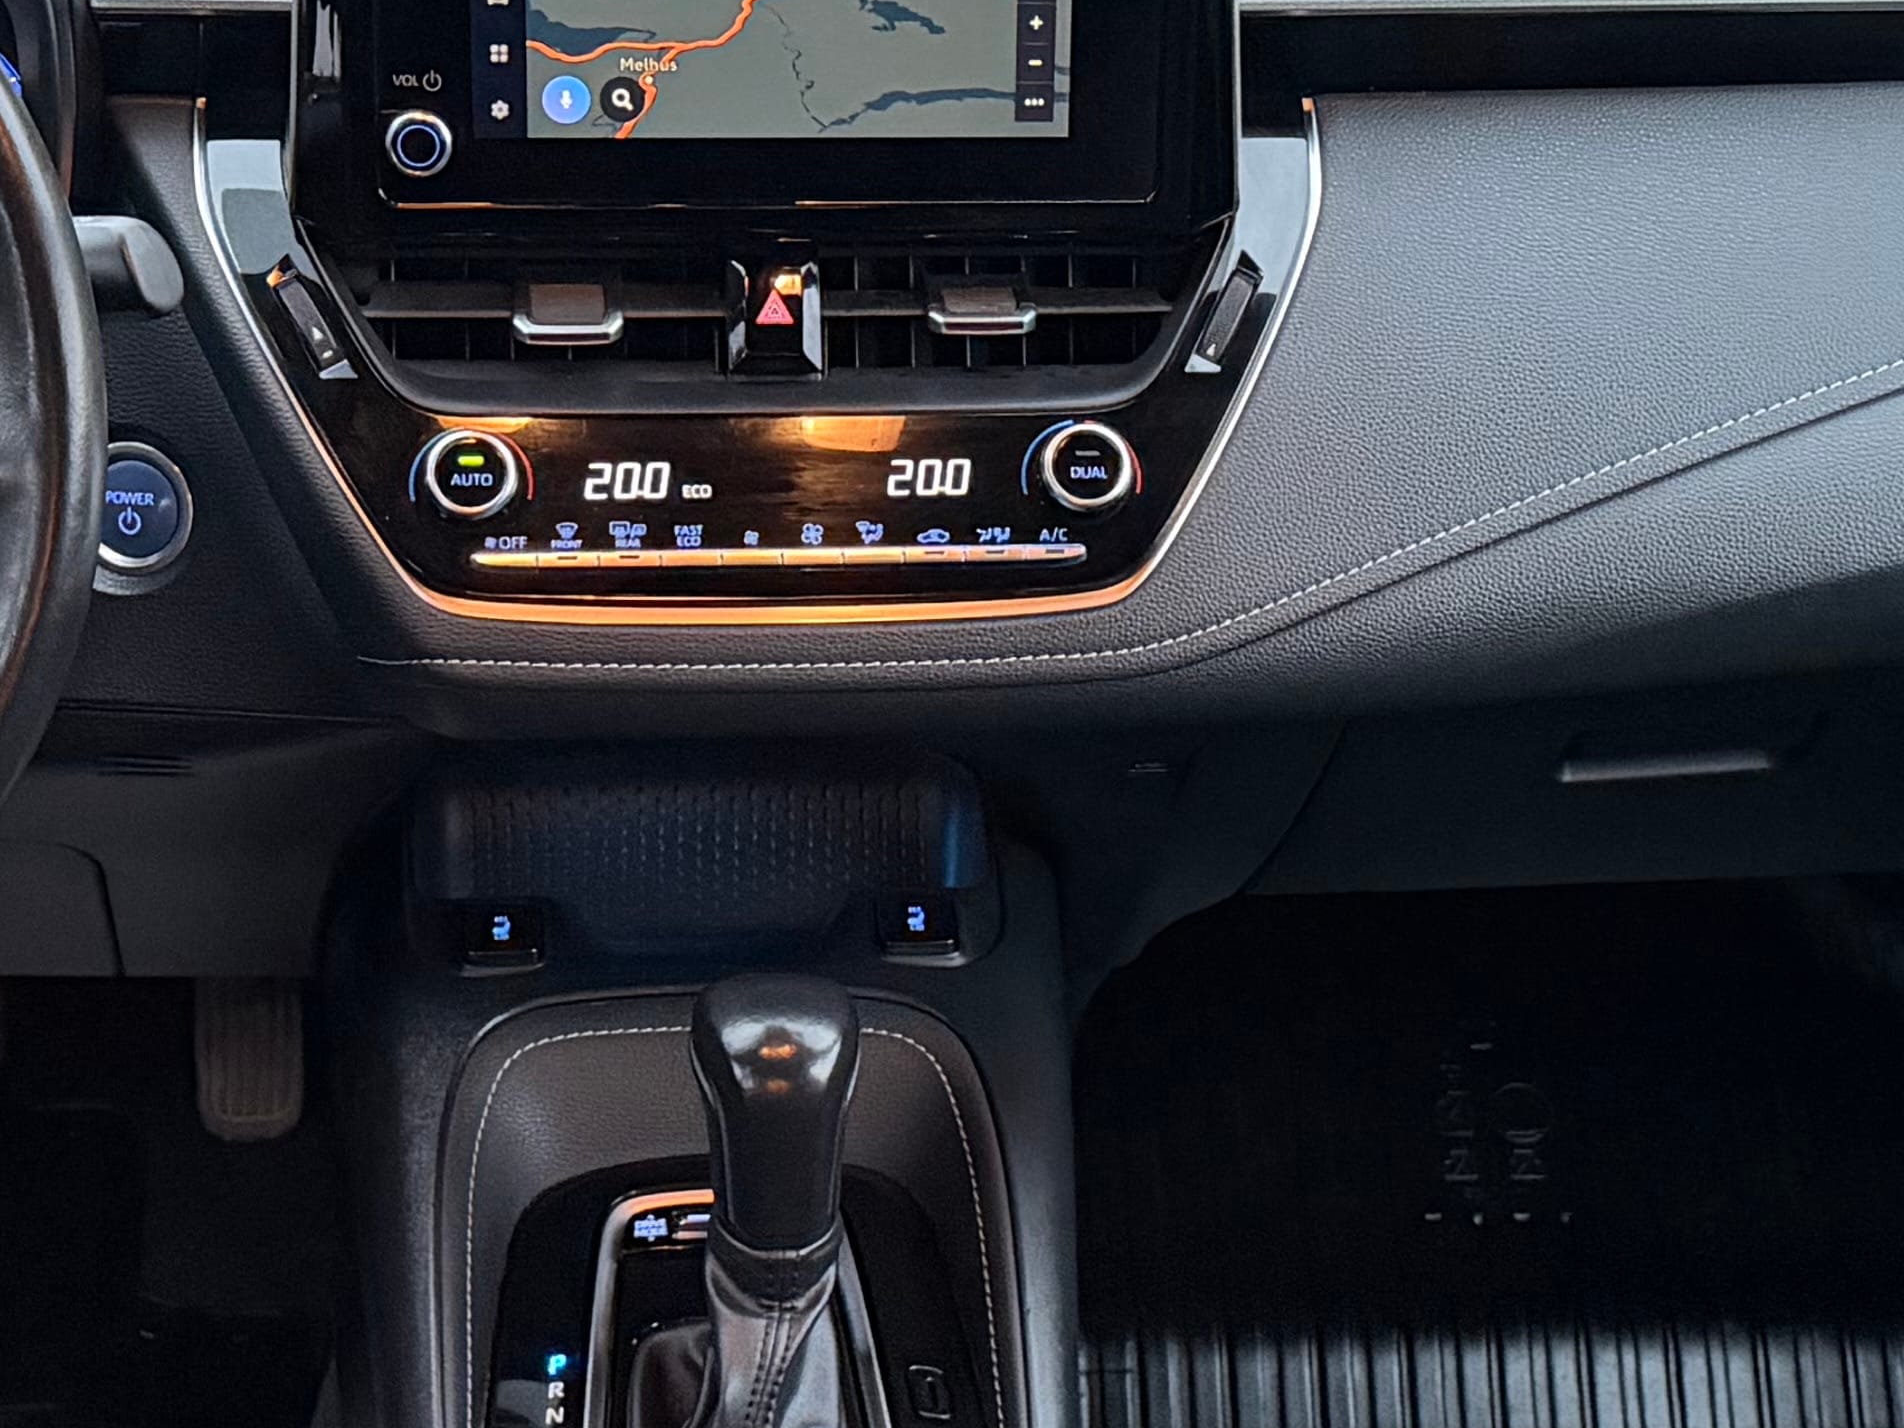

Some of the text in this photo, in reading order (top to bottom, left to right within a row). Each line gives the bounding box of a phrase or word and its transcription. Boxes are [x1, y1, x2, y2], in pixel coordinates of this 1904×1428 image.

[619, 57, 678, 73] Melhus
[392, 73, 418, 88] VOL
[450, 473, 494, 487] AUTO
[1070, 466, 1108, 480] DUAL
[105, 490, 154, 506] POWER
[681, 484, 713, 499] ECO
[674, 524, 703, 537] FAST
[1039, 528, 1068, 542] A/C
[498, 536, 528, 550] OFF
[550, 539, 583, 549] FRONT
[676, 535, 702, 548] ECO
[548, 1354, 567, 1376] P
[548, 1381, 565, 1399] R
[545, 1406, 564, 1425] N
